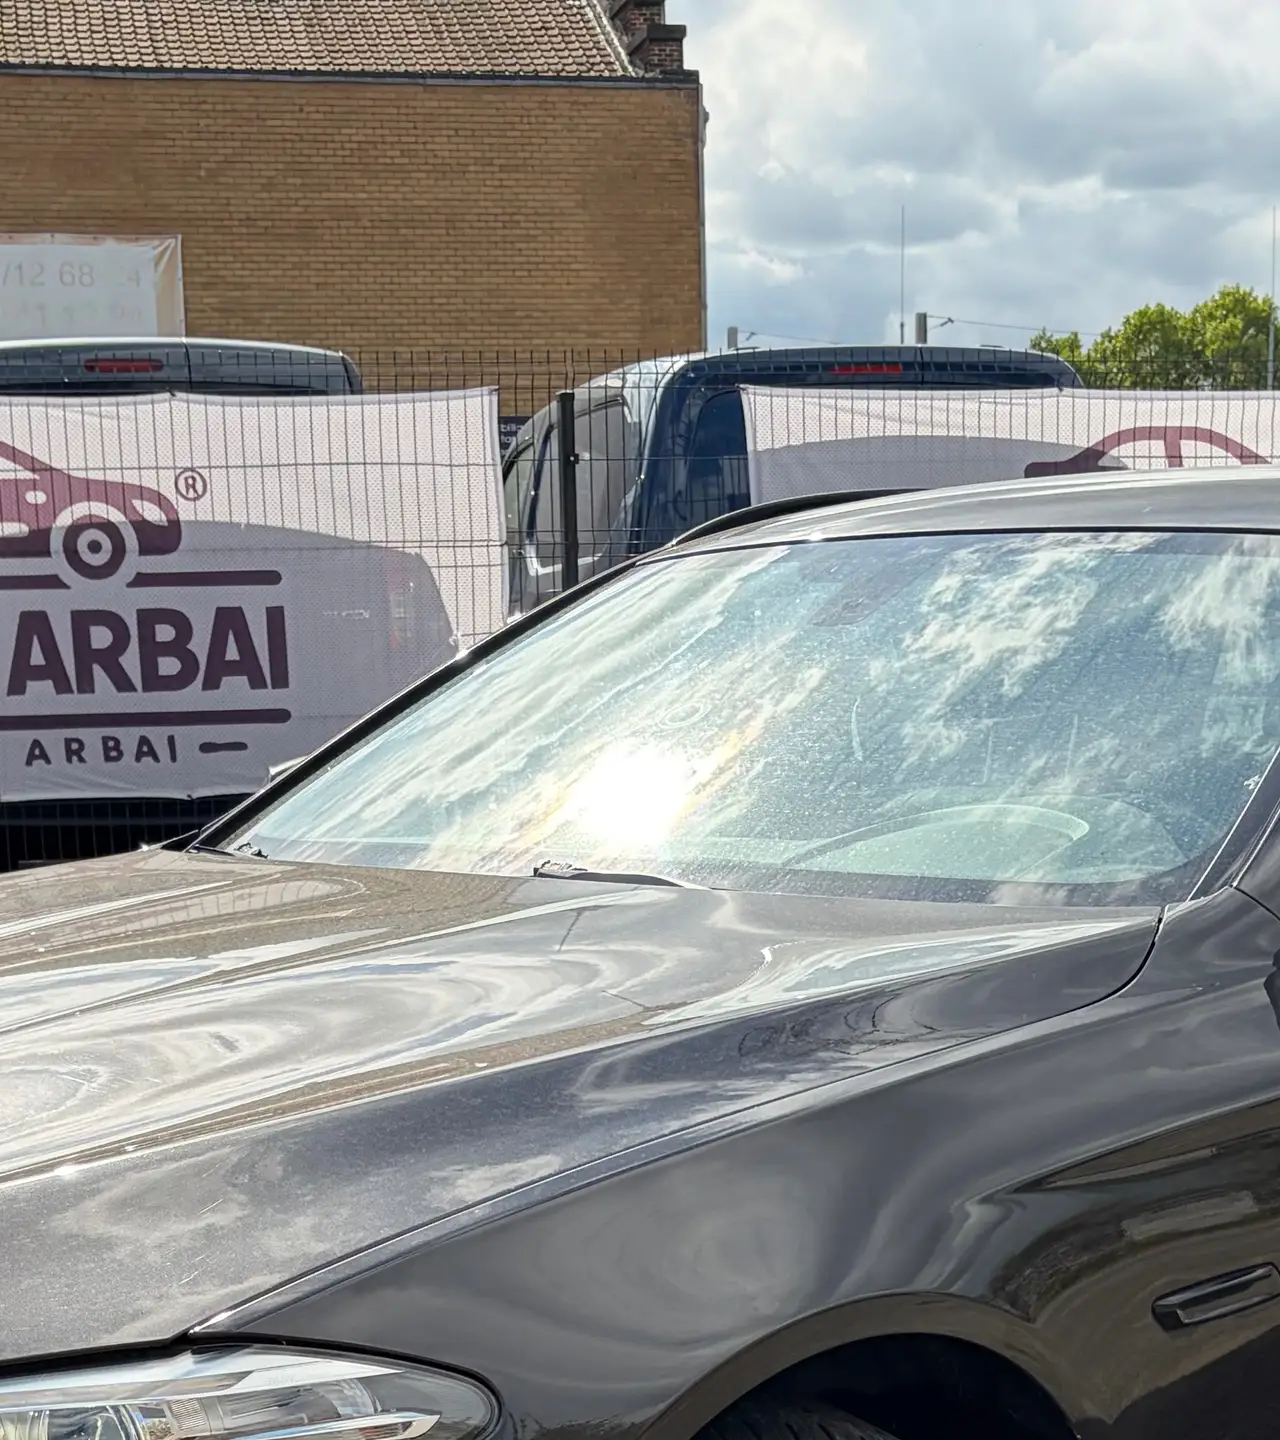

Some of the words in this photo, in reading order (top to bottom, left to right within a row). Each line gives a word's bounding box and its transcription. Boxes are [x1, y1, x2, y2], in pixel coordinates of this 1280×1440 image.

[59, 262, 95, 288] 68
[6, 605, 290, 697] ARBAI
[25, 734, 177, 767] ARBAI
